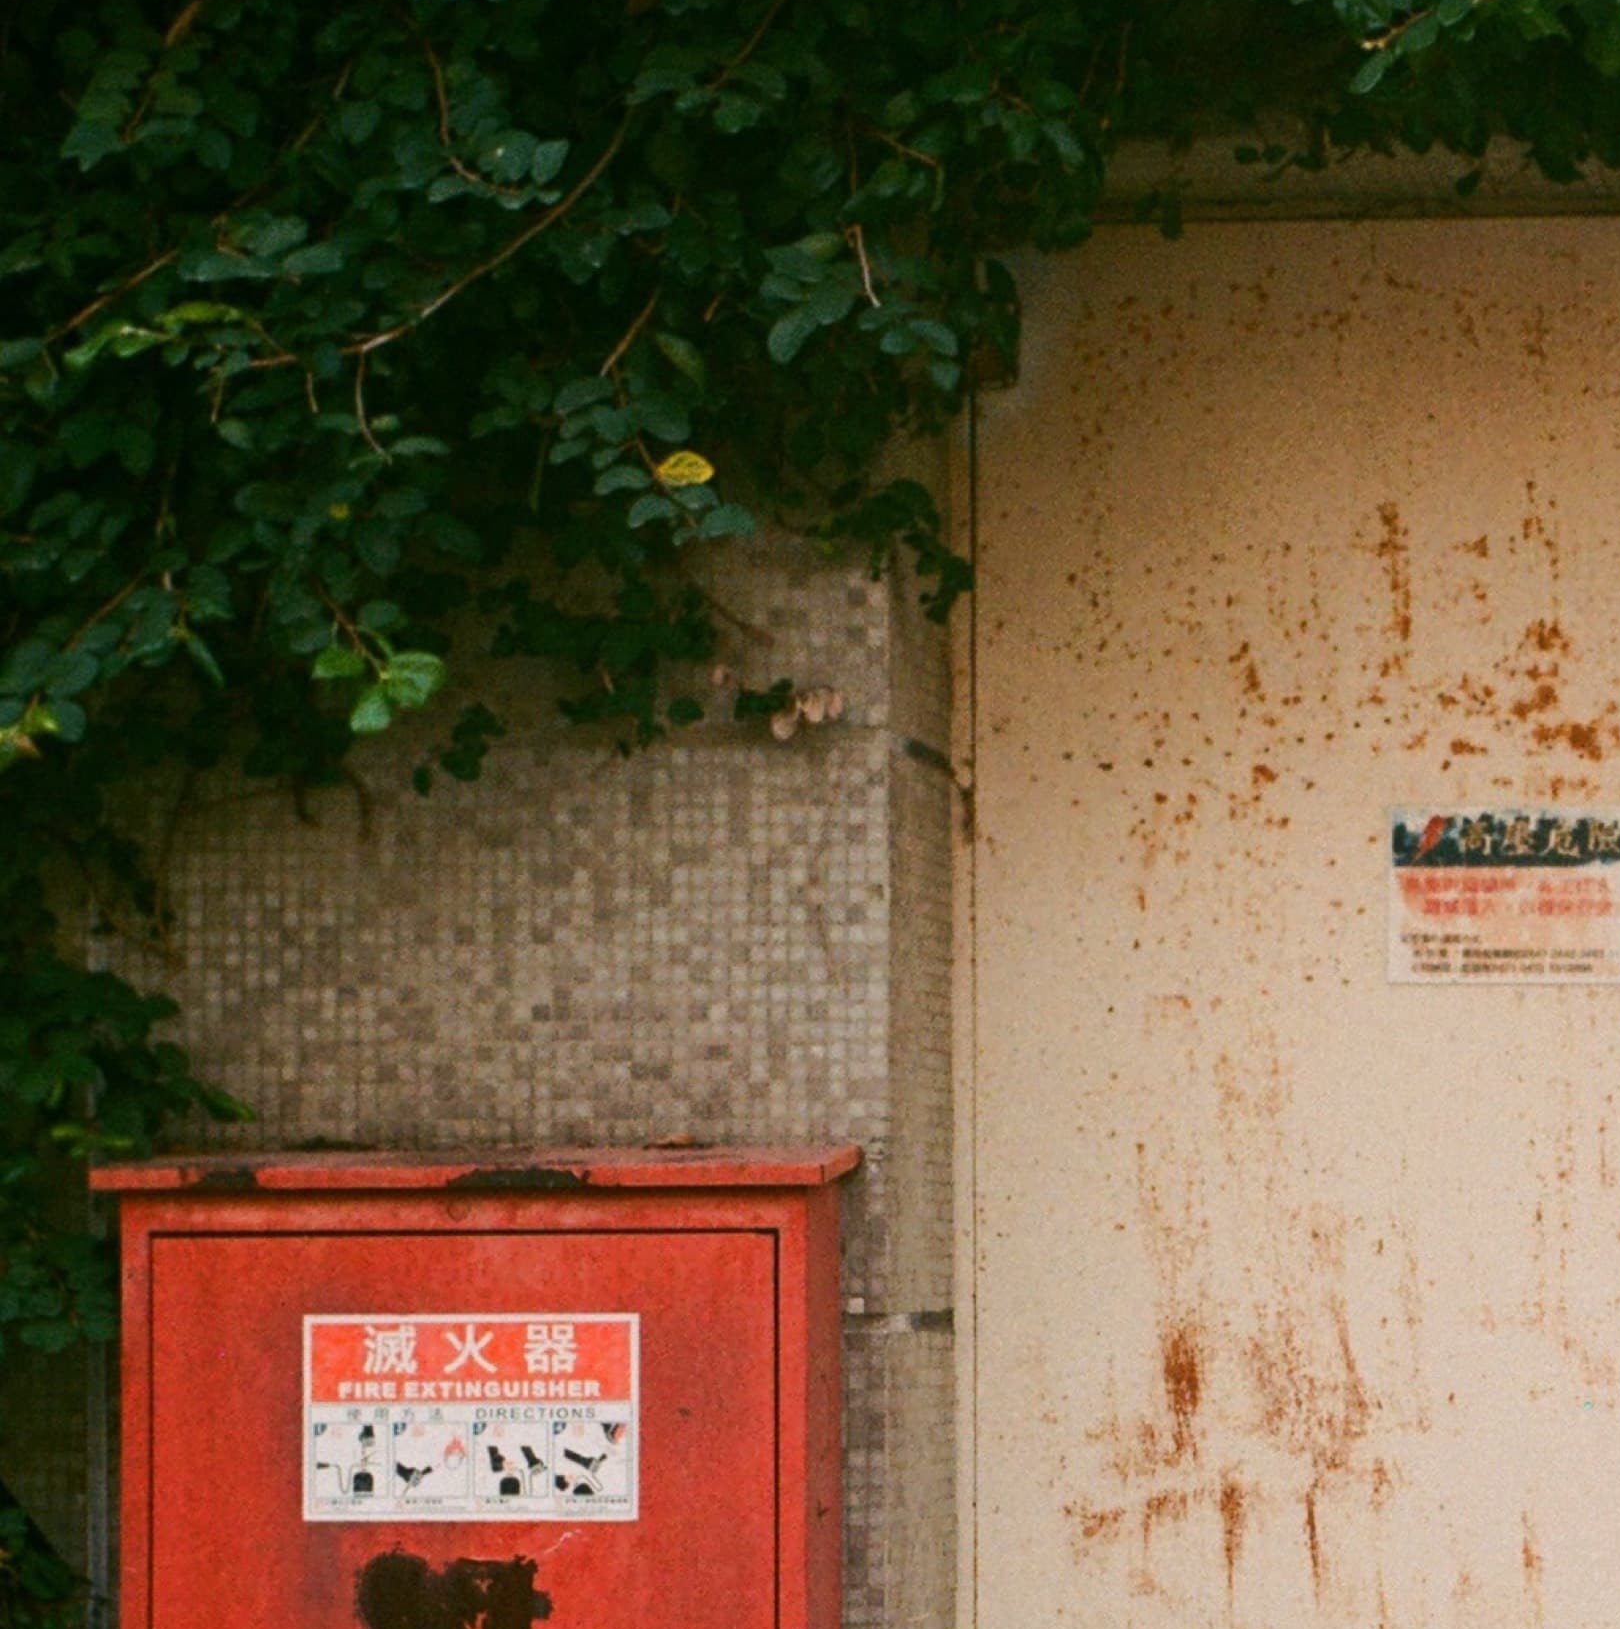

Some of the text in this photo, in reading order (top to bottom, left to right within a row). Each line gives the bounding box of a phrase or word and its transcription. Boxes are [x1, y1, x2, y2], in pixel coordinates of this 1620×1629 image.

[362, 1323, 579, 1375] 滅火器
[337, 1379, 601, 1400] FIRE EXTINGUISHER
[474, 1406, 598, 1421] DIRECTIONS
